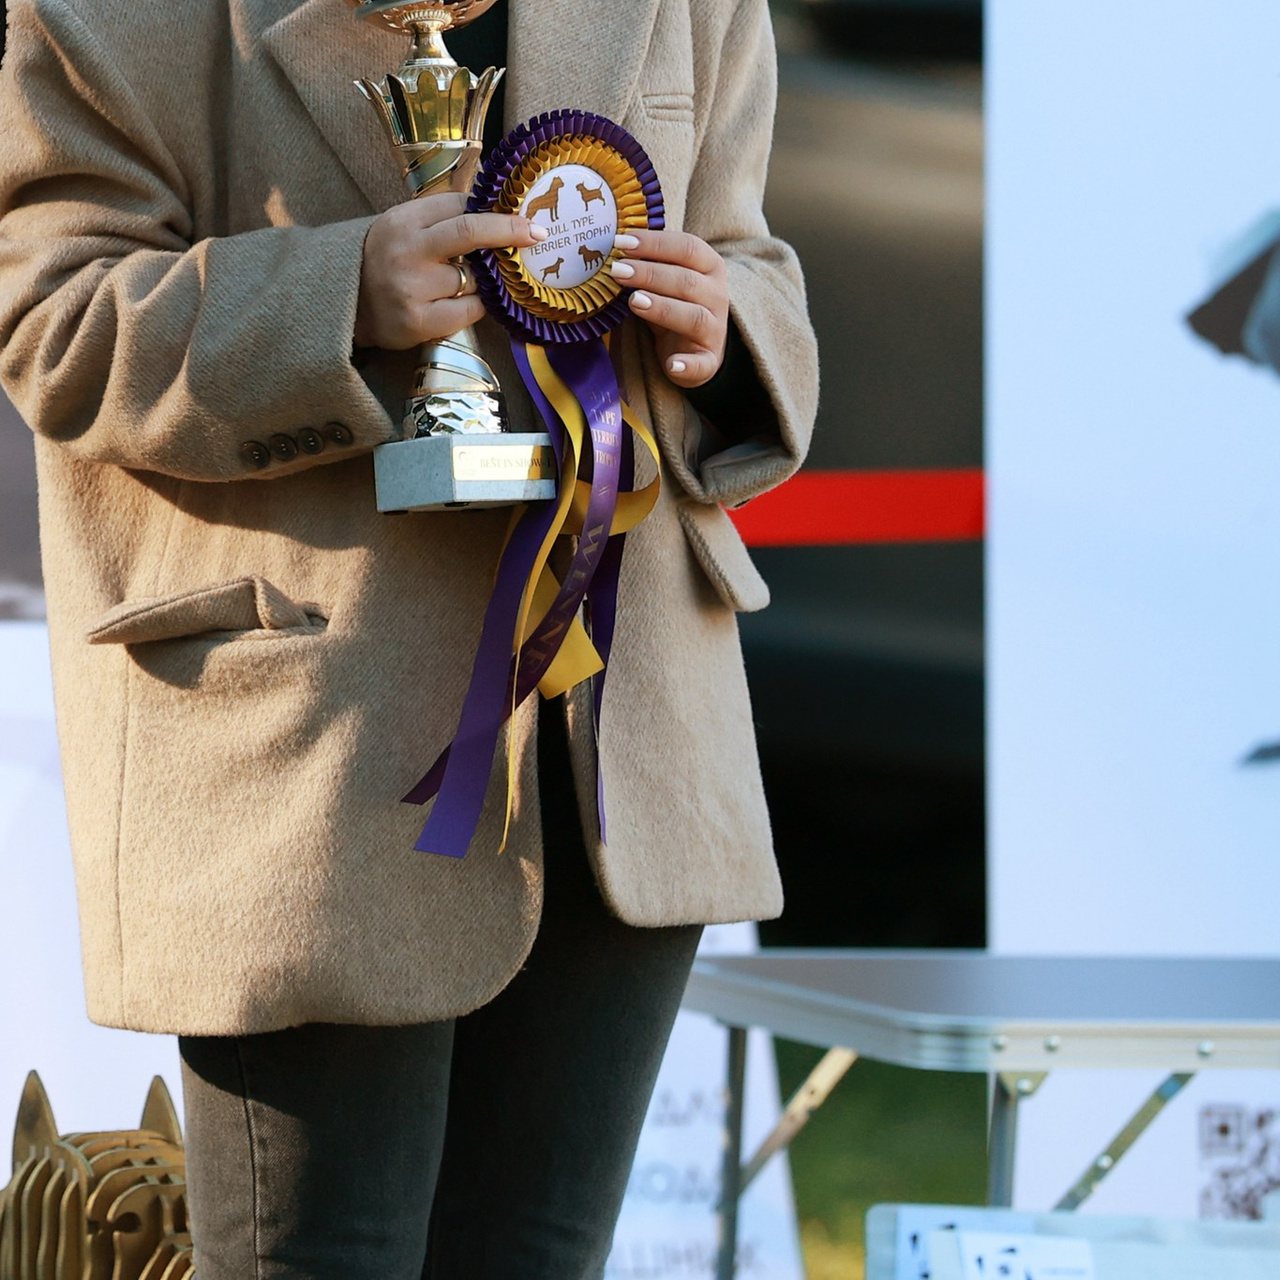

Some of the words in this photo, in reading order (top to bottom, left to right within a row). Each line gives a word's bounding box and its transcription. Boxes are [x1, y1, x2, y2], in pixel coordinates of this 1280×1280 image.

[528, 236, 571, 257] TERRIER
[574, 223, 613, 244] TROPHY
[545, 223, 569, 238] BULL
[570, 214, 595, 229] TYPE
[522, 523, 605, 674] WINNE
